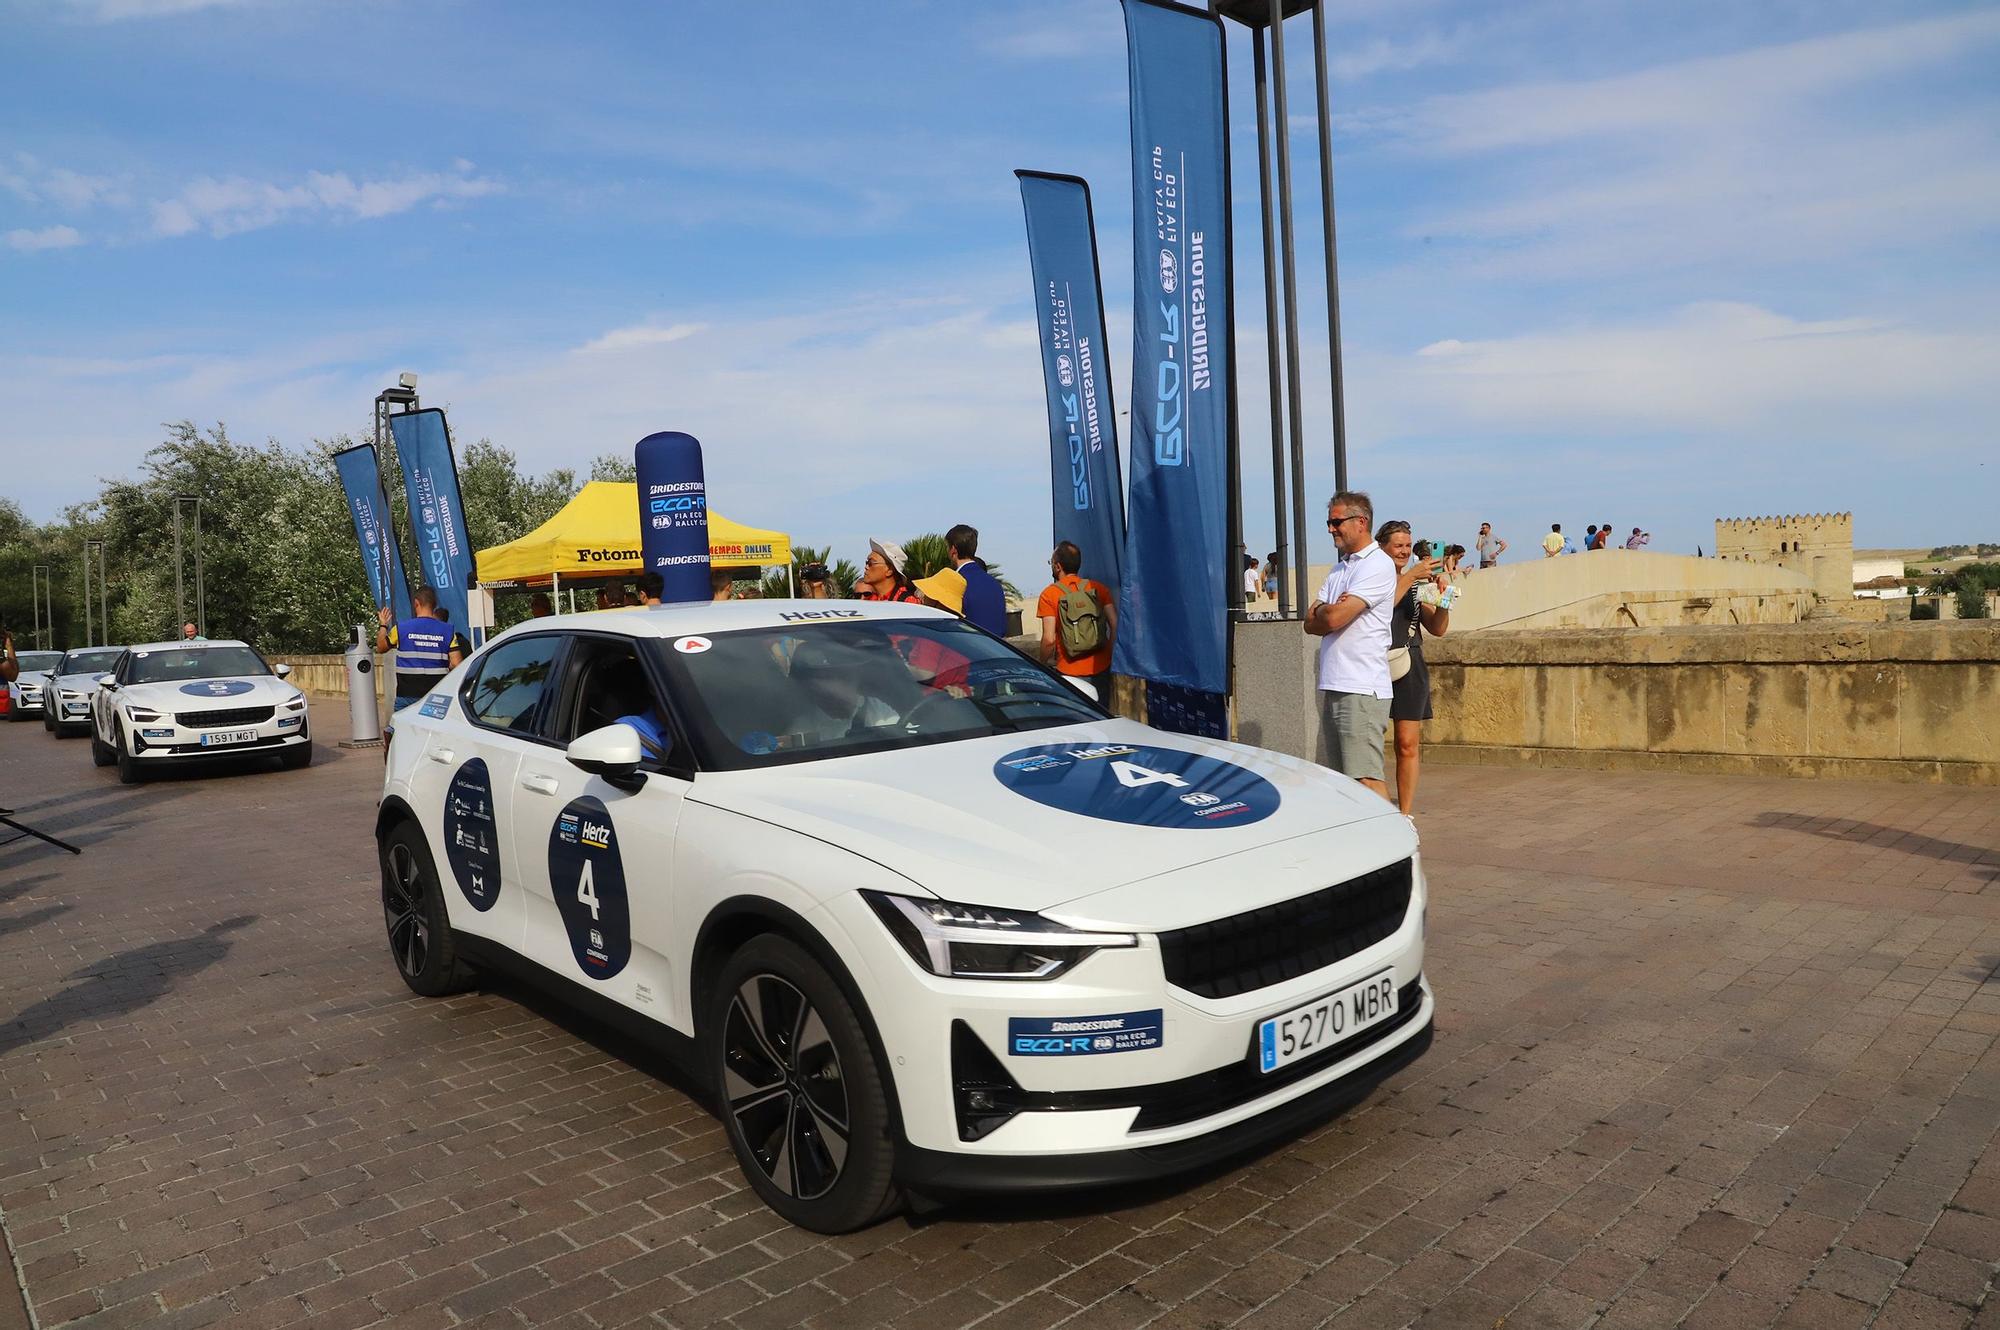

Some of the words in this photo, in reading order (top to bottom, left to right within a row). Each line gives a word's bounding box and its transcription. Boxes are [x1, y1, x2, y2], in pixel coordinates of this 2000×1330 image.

[652, 515, 671, 529] FIA
[674, 512, 688, 520] FIA
[690, 511, 702, 519] ECO
[675, 519, 698, 527] RALLY
[745, 544, 772, 554] ONLINE
[779, 609, 865, 621] Hertz
[685, 640, 705, 650] A
[210, 733, 233, 744] 1591
[236, 731, 254, 741] MGT
[1066, 744, 1138, 760] Hertz
[1110, 760, 1190, 788] 4
[582, 821, 610, 844] Hertz
[577, 859, 600, 921] 4
[1282, 1000, 1345, 1057] 5270
[1353, 978, 1393, 1026] MBR
[1051, 1019, 1125, 1032] BRIDGESTONE
[1130, 1032, 1146, 1040] ECO
[1093, 1037, 1114, 1050] FIA
[1115, 1040, 1139, 1049] RALLY
[1140, 1038, 1157, 1046] CUP
